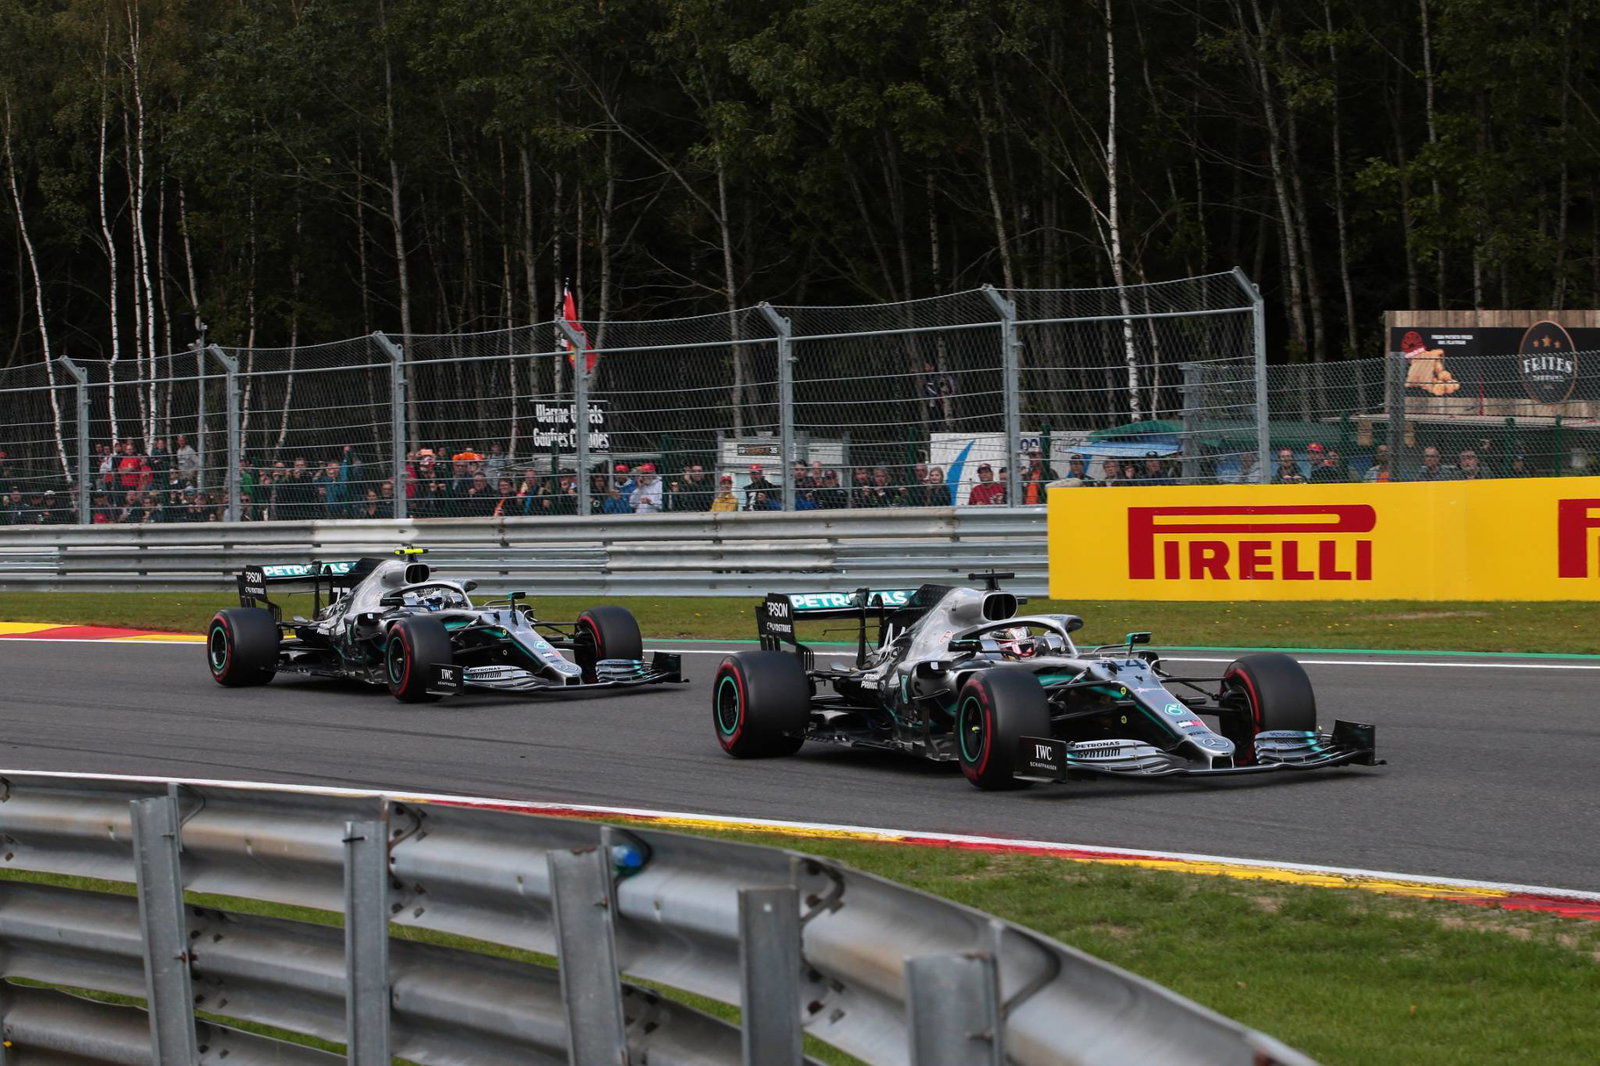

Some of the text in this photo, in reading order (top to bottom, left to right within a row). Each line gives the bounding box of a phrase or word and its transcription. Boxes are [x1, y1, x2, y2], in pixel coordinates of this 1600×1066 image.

[1523, 356, 1572, 373] FRITES
[1127, 504, 1377, 581] PIRELLI
[441, 669, 454, 681] IWC
[1035, 744, 1053, 761] IWC
[1075, 741, 1120, 749] PETRONAS
